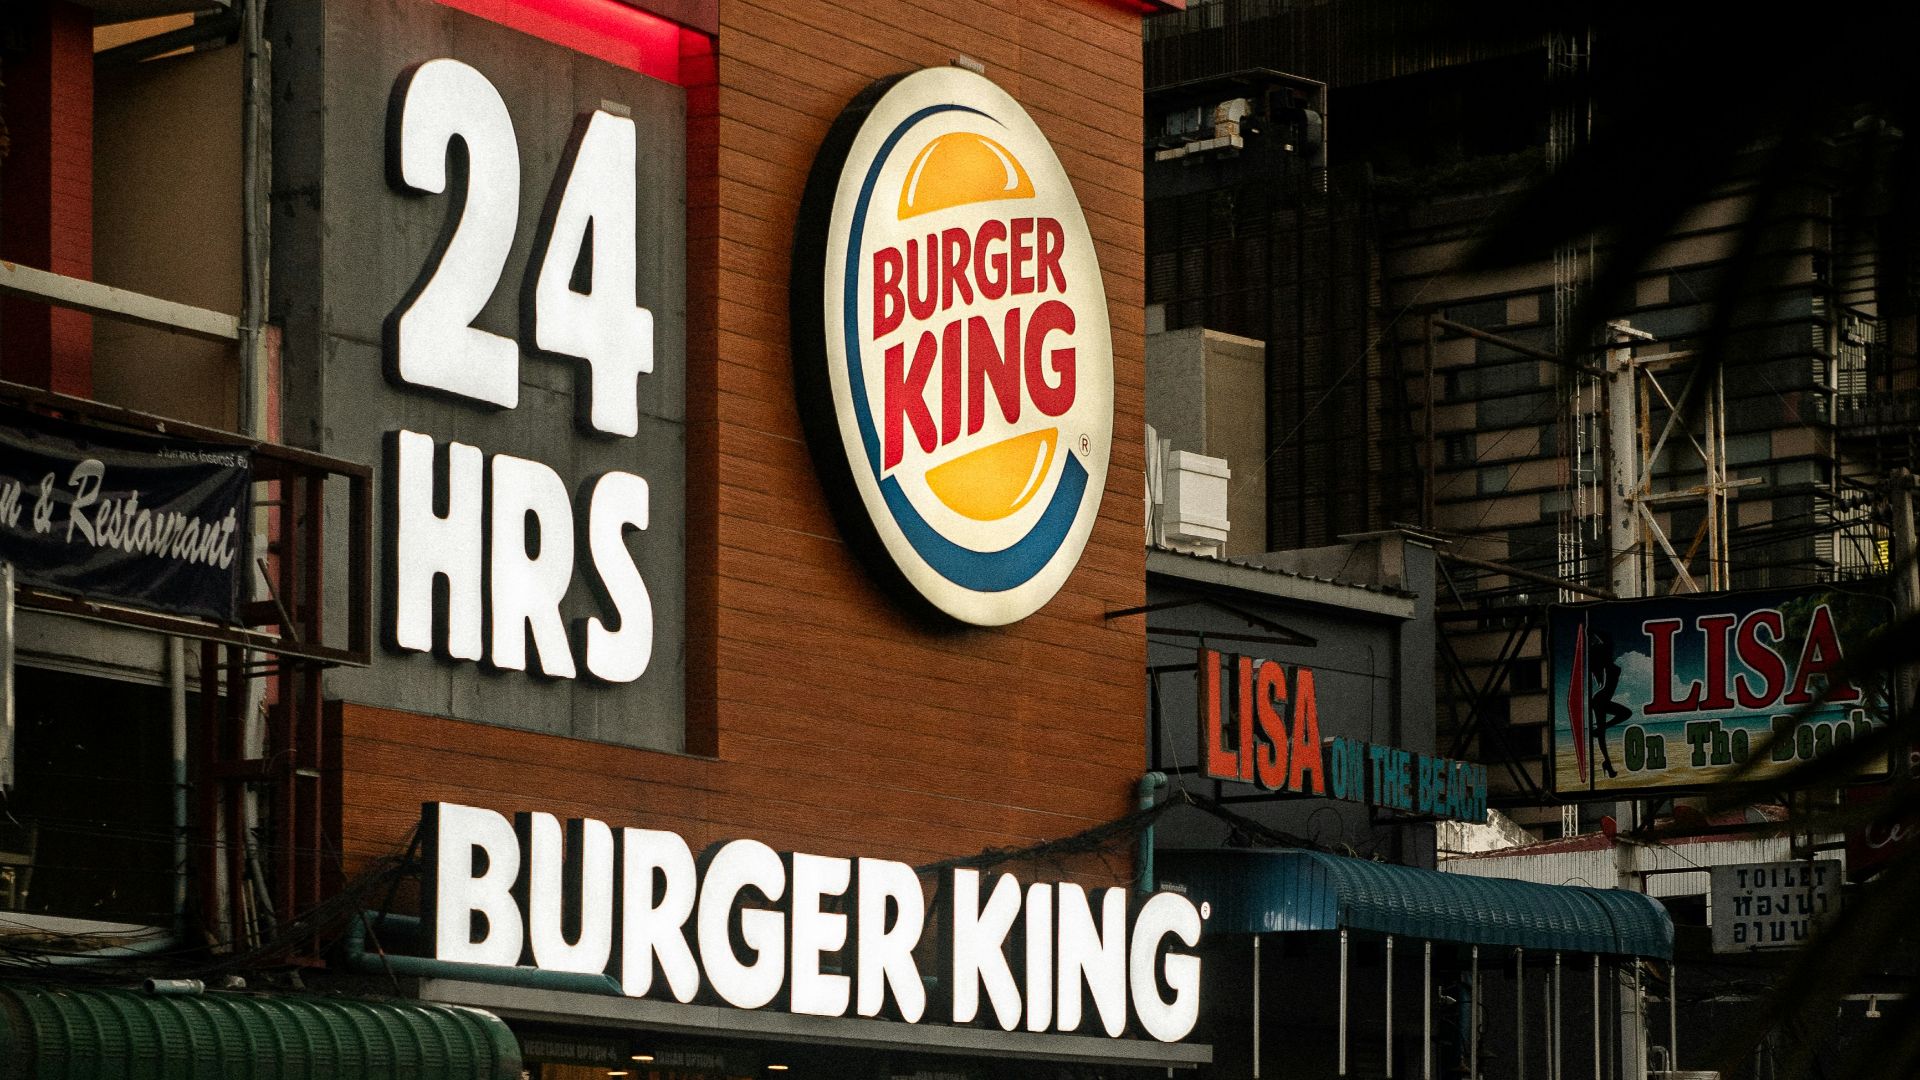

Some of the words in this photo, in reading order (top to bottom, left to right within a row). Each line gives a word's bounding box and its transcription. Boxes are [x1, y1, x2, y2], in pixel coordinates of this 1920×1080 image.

[398, 57, 654, 438] 24
[873, 217, 1067, 341] BURGER
[884, 300, 1076, 471] KING
[33, 472, 55, 533] &
[66, 459, 236, 570] Restaurant
[397, 429, 654, 683] HRS
[1640, 602, 1863, 718] LISA
[1204, 649, 1326, 796] LISA
[1331, 735, 1365, 801] ON
[1369, 743, 1413, 811] THE
[1417, 752, 1488, 825] BEACH
[1623, 725, 1667, 772] On
[1685, 719, 1749, 767] The
[435, 801, 927, 1024] BURGER
[952, 867, 1202, 1043] KING
[1736, 866, 1827, 889] TOILET
